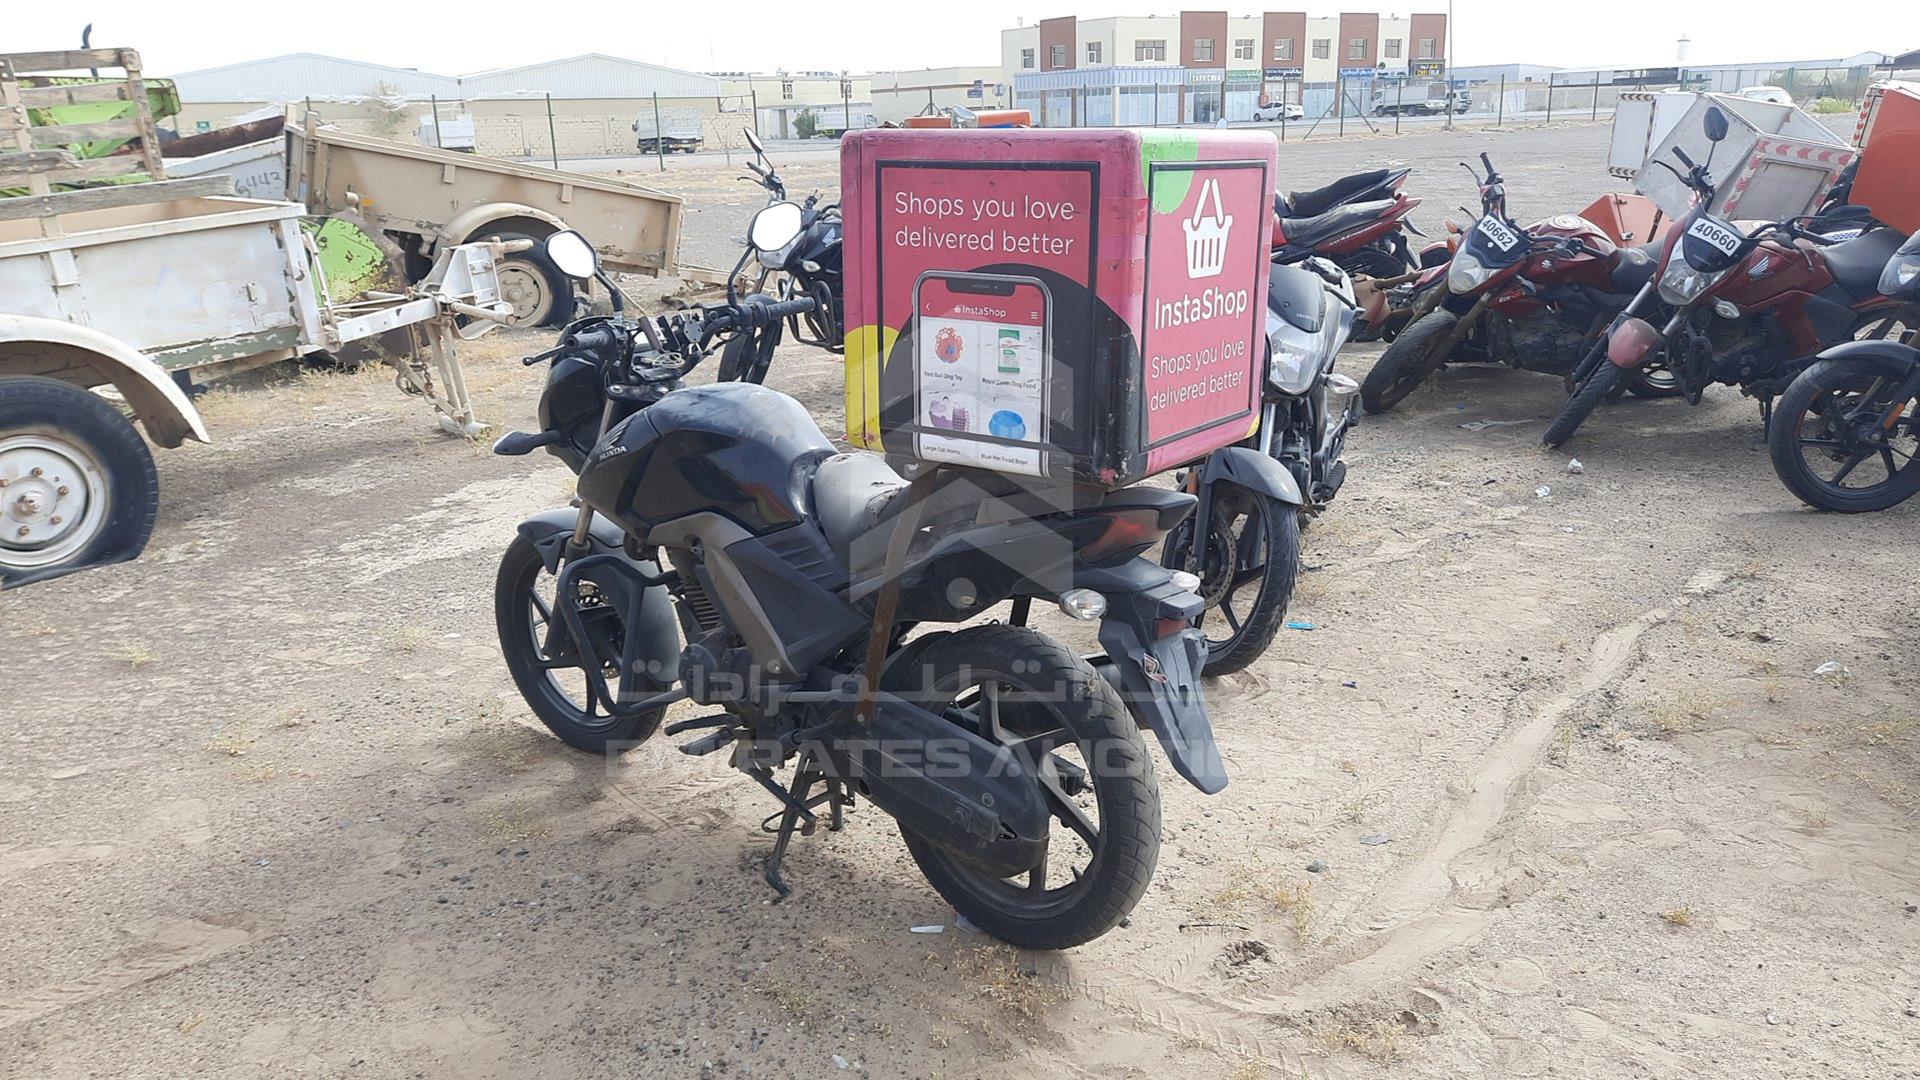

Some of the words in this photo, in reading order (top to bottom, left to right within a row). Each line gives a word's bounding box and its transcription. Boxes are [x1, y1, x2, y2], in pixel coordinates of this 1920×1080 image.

[895, 191, 964, 219] Shops
[971, 199, 1015, 221] you
[1024, 195, 1075, 220] love
[895, 225, 994, 251] delivered
[1002, 229, 1075, 255] better
[1483, 219, 1513, 248] 40662
[1694, 222, 1736, 251] 40660
[962, 305, 1007, 318] InstaShop
[1155, 286, 1248, 330] InstaShop
[1151, 353, 1192, 378] Shops
[1195, 347, 1218, 371] you
[1221, 339, 1245, 360] love
[1150, 376, 1206, 411] delivered
[1209, 370, 1244, 393] better
